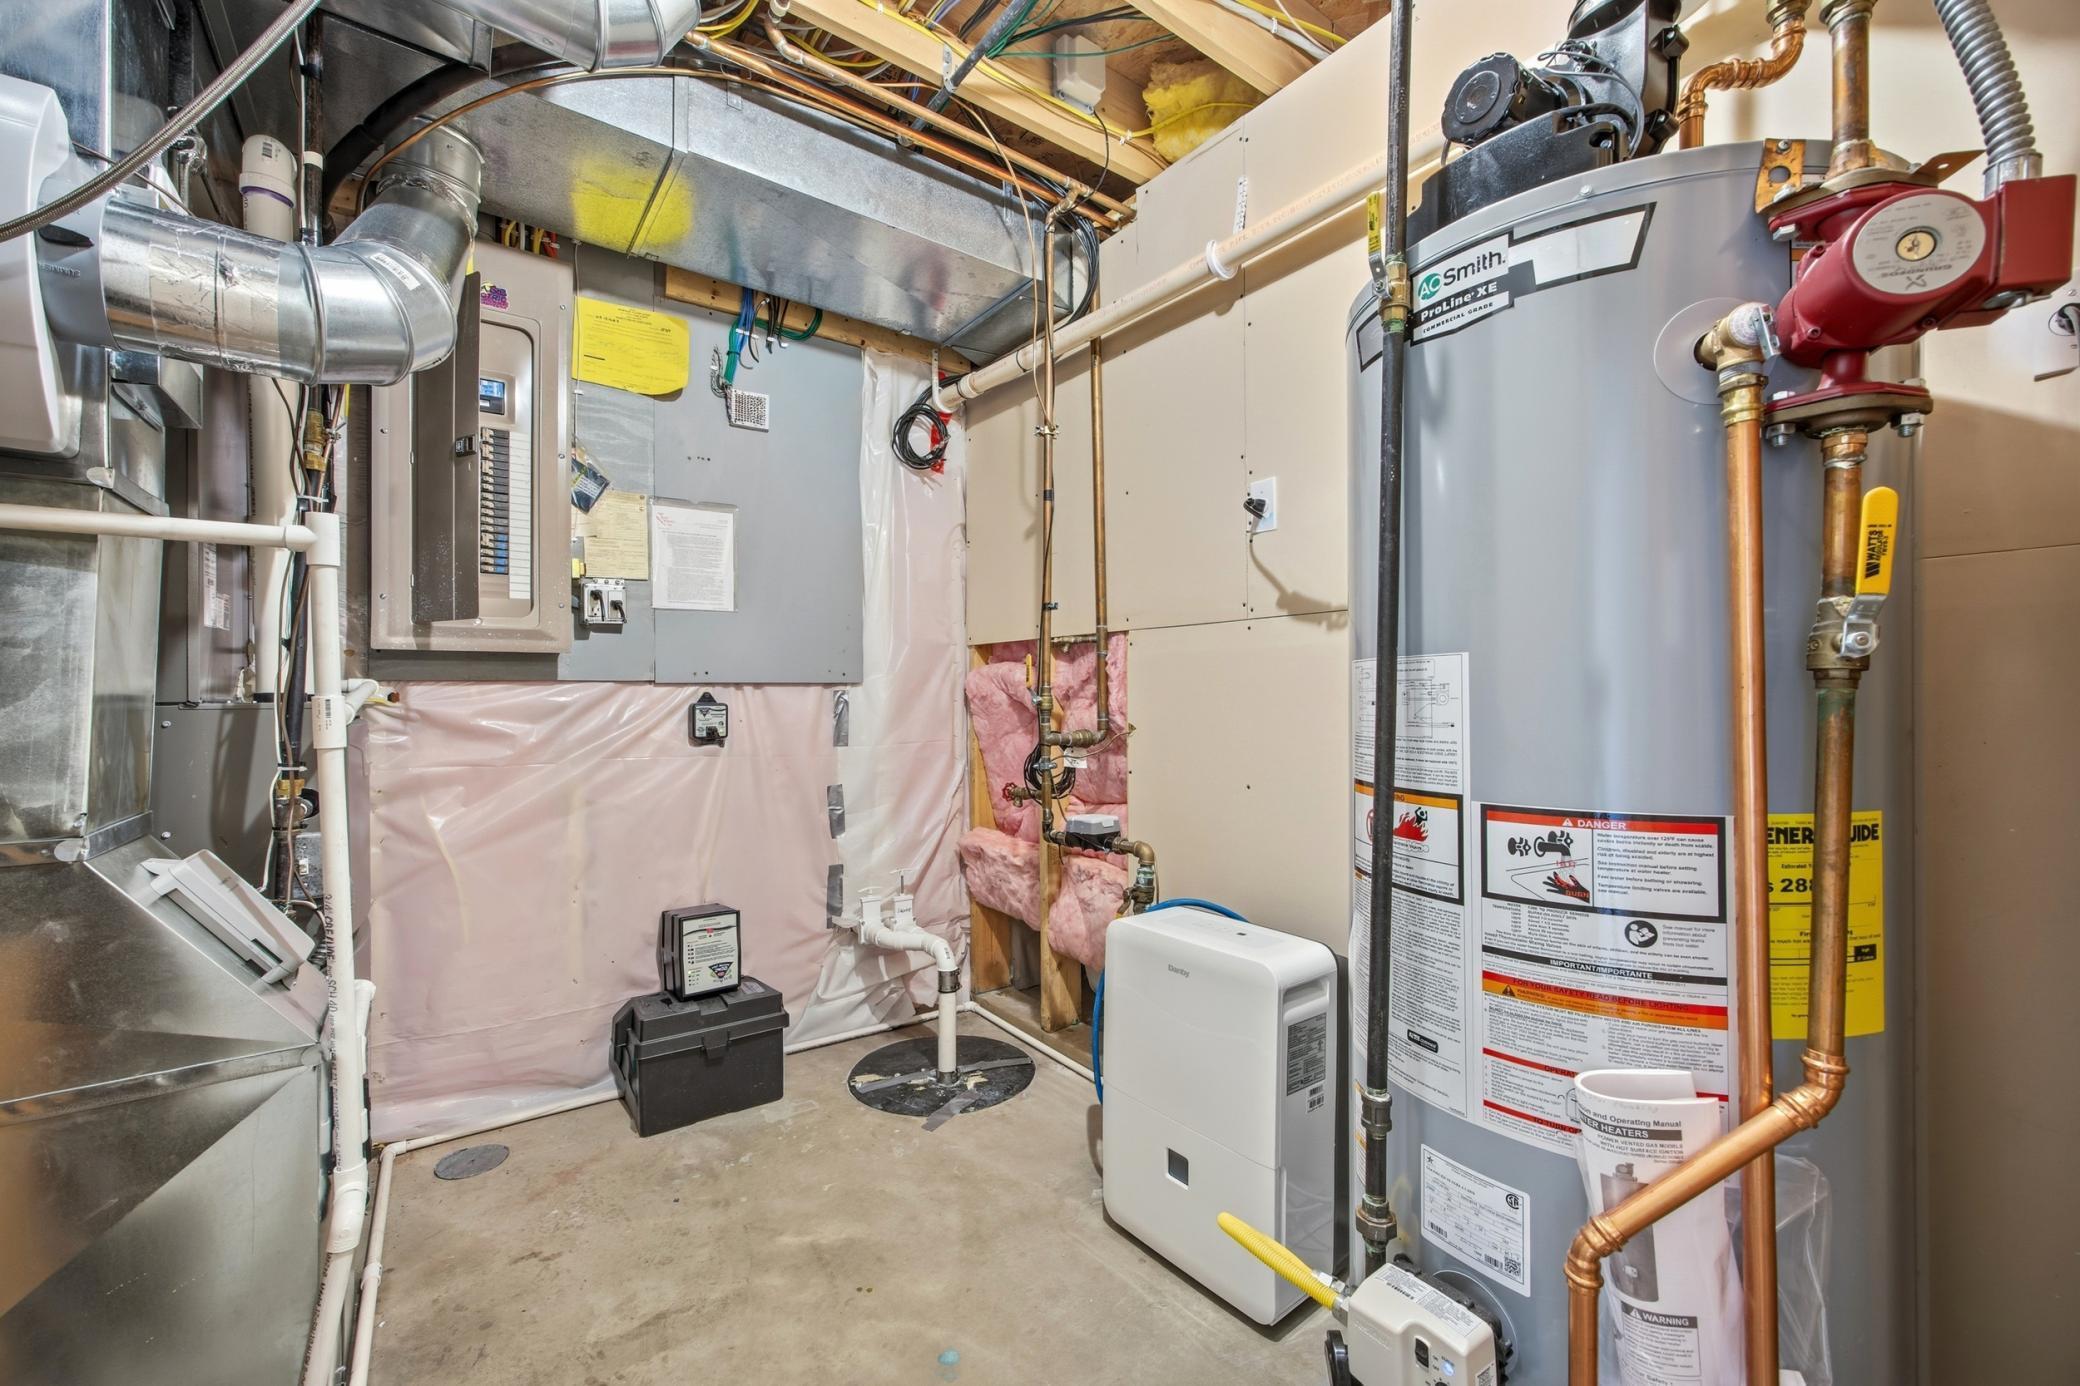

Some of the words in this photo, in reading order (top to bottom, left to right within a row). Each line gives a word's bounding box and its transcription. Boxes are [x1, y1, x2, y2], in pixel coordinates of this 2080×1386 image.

[1477, 282, 1498, 298] XE
[1422, 312, 1466, 333] COMMERCIAL
[1468, 302, 1494, 315] GRADE
[1577, 819, 1627, 831] DANGER
[1768, 827, 1814, 844] ENER
[1851, 823, 1879, 842] UIDE
[1167, 964, 1190, 979] Danby
[1593, 1111, 1607, 1120] and
[1610, 1115, 1651, 1127] Operating
[1600, 1125, 1649, 1138] HEATERS
[1643, 1312, 1689, 1326] WARNING
